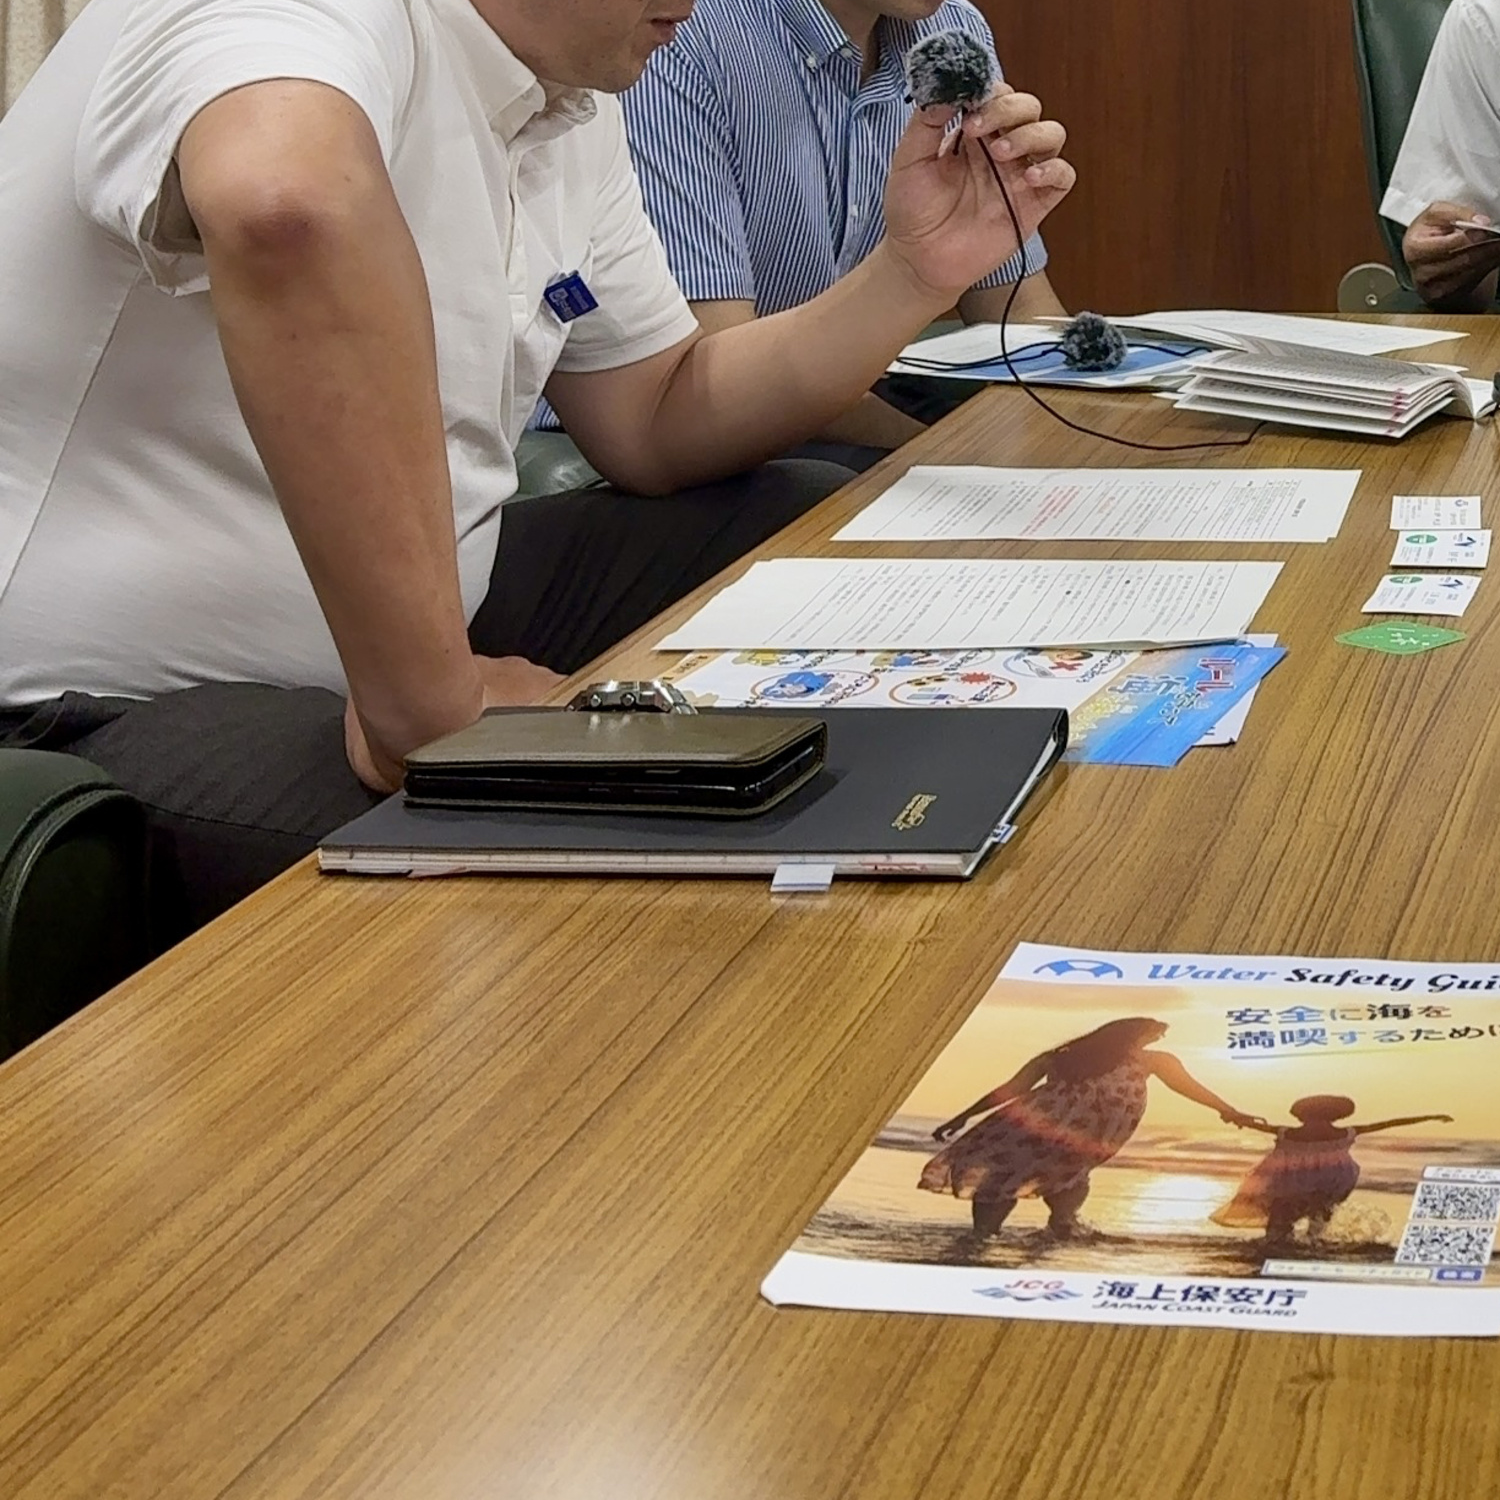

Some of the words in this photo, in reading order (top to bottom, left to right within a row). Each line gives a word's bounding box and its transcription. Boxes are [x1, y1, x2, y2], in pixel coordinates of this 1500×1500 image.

[1147, 964, 1277, 981] Water
[1284, 968, 1415, 991] Safety
[1225, 1003, 1453, 1027] 安全に海を
[1005, 1279, 1065, 1290] JCG
[1092, 1280, 1308, 1307] 海上保安庁
